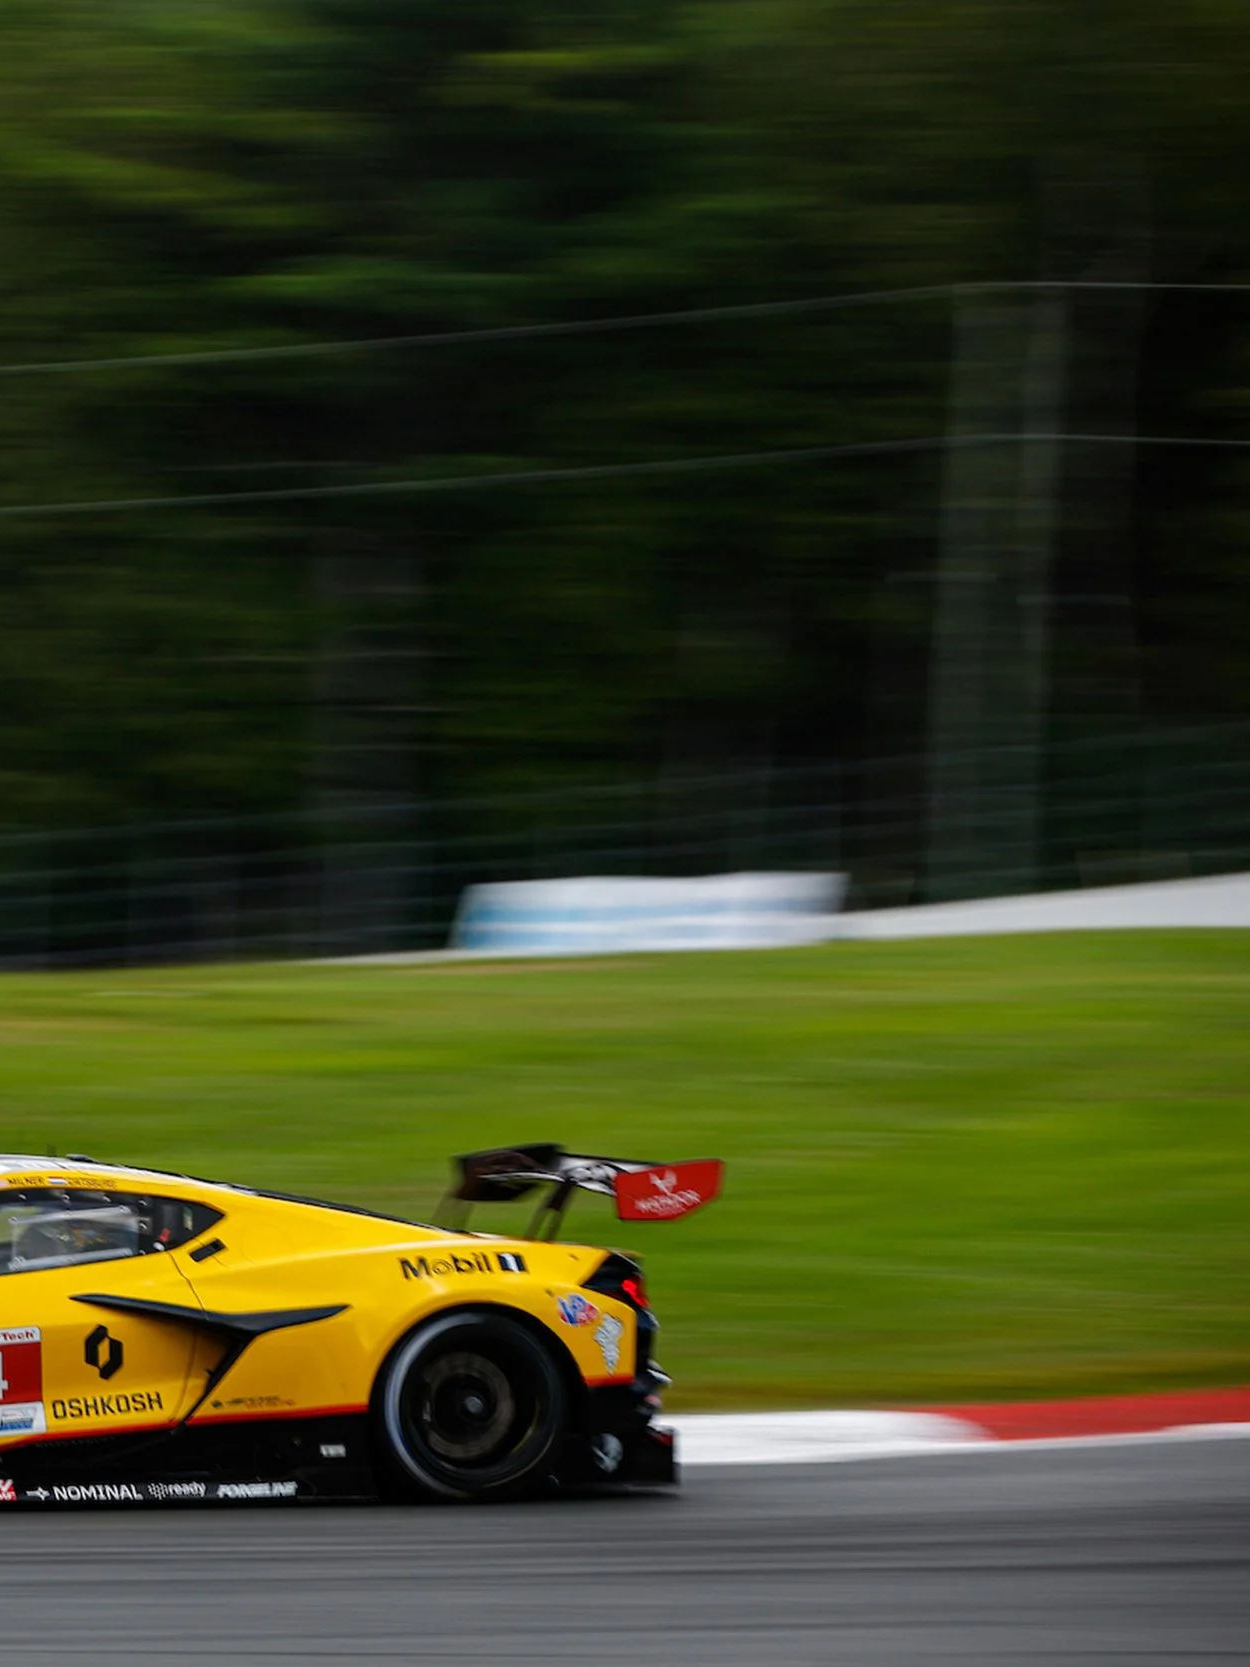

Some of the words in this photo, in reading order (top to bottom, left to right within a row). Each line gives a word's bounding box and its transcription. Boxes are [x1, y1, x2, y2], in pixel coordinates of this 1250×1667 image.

[399, 1251, 494, 1281] Mobil
[51, 1391, 164, 1420] OSHKOSH
[52, 1483, 144, 1501] NOMINAL
